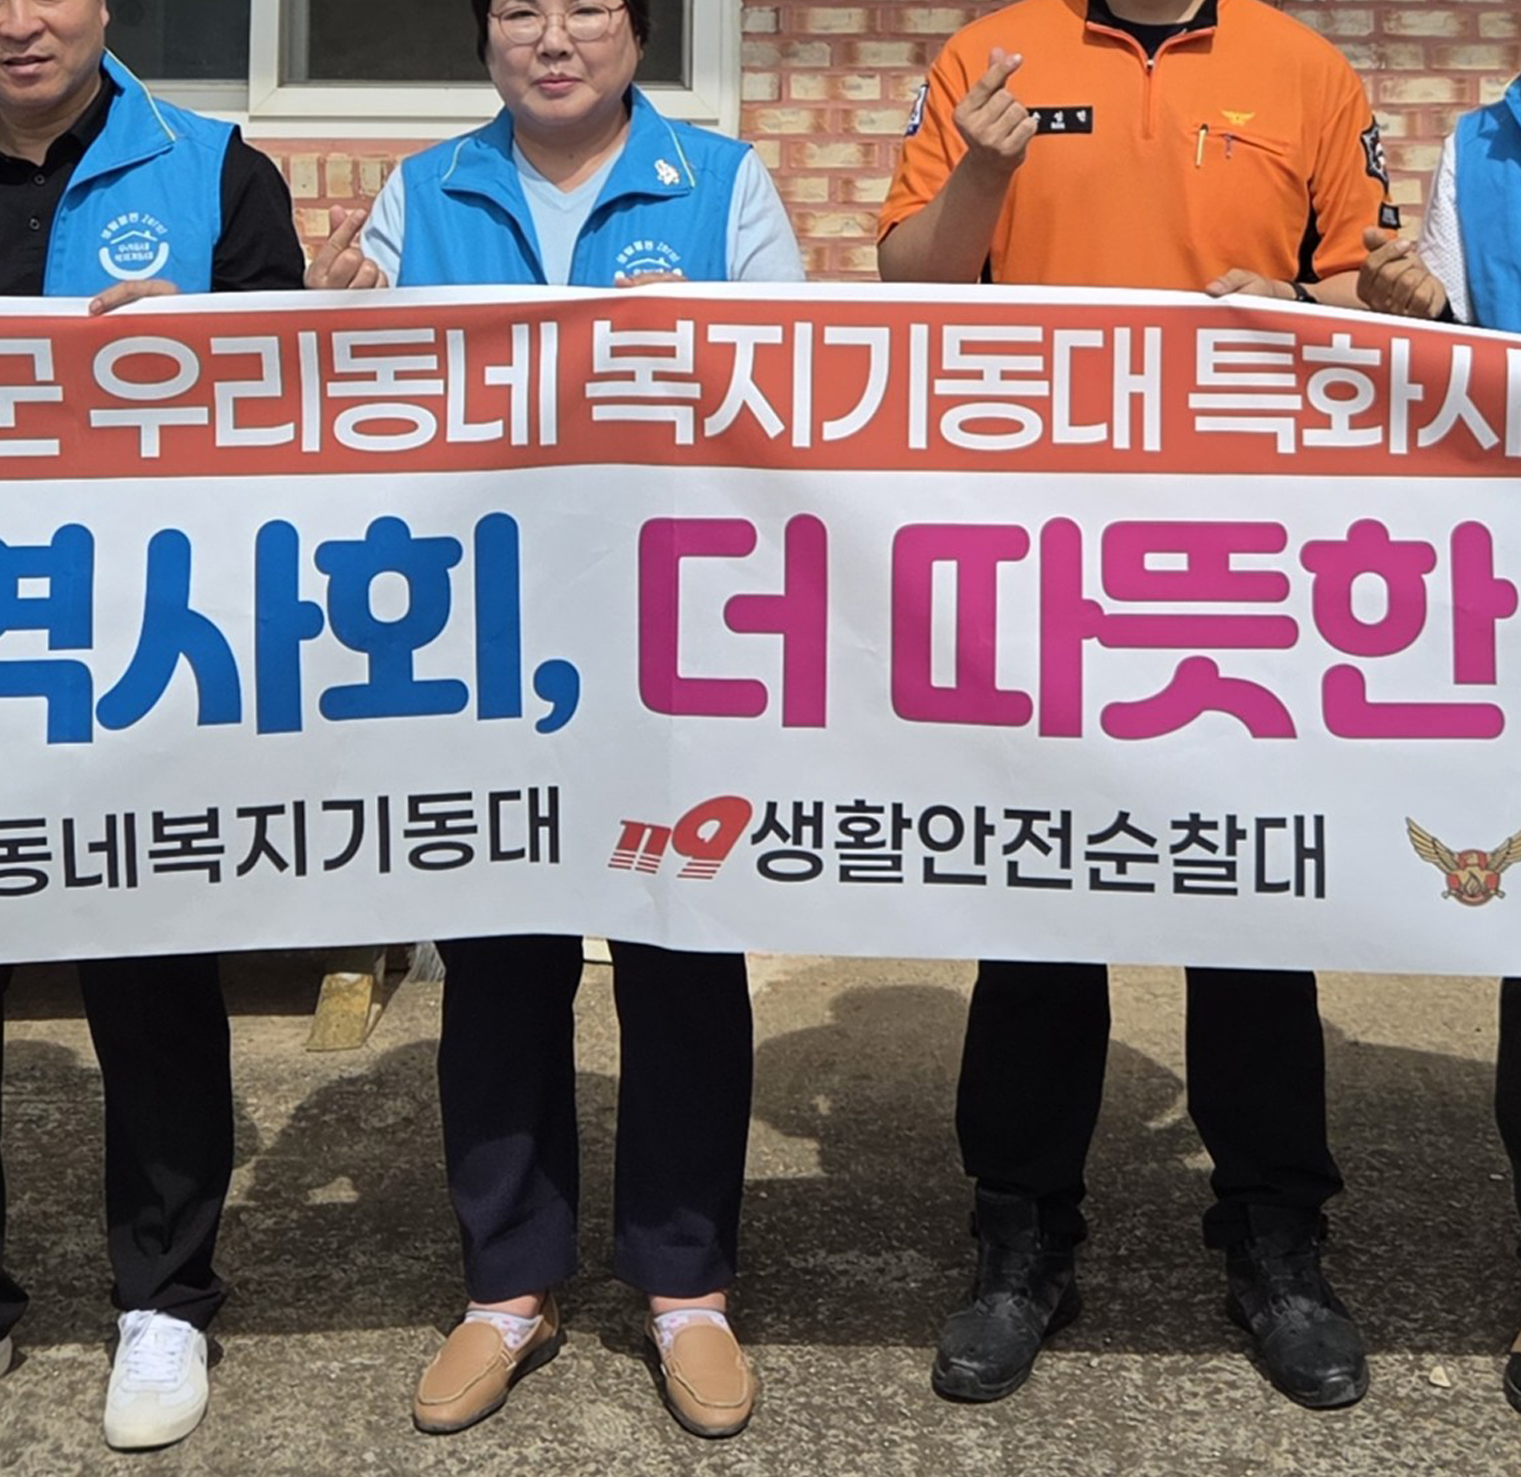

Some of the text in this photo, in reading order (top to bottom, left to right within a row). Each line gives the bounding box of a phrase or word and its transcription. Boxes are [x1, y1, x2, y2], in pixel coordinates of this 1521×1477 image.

[89, 320, 558, 458] 우리동네
[584, 320, 1161, 452] 복지기동대
[637, 513, 829, 729] 더
[890, 515, 1519, 742] 따뜻한
[750, 797, 1328, 901] 생활안전순찰대
